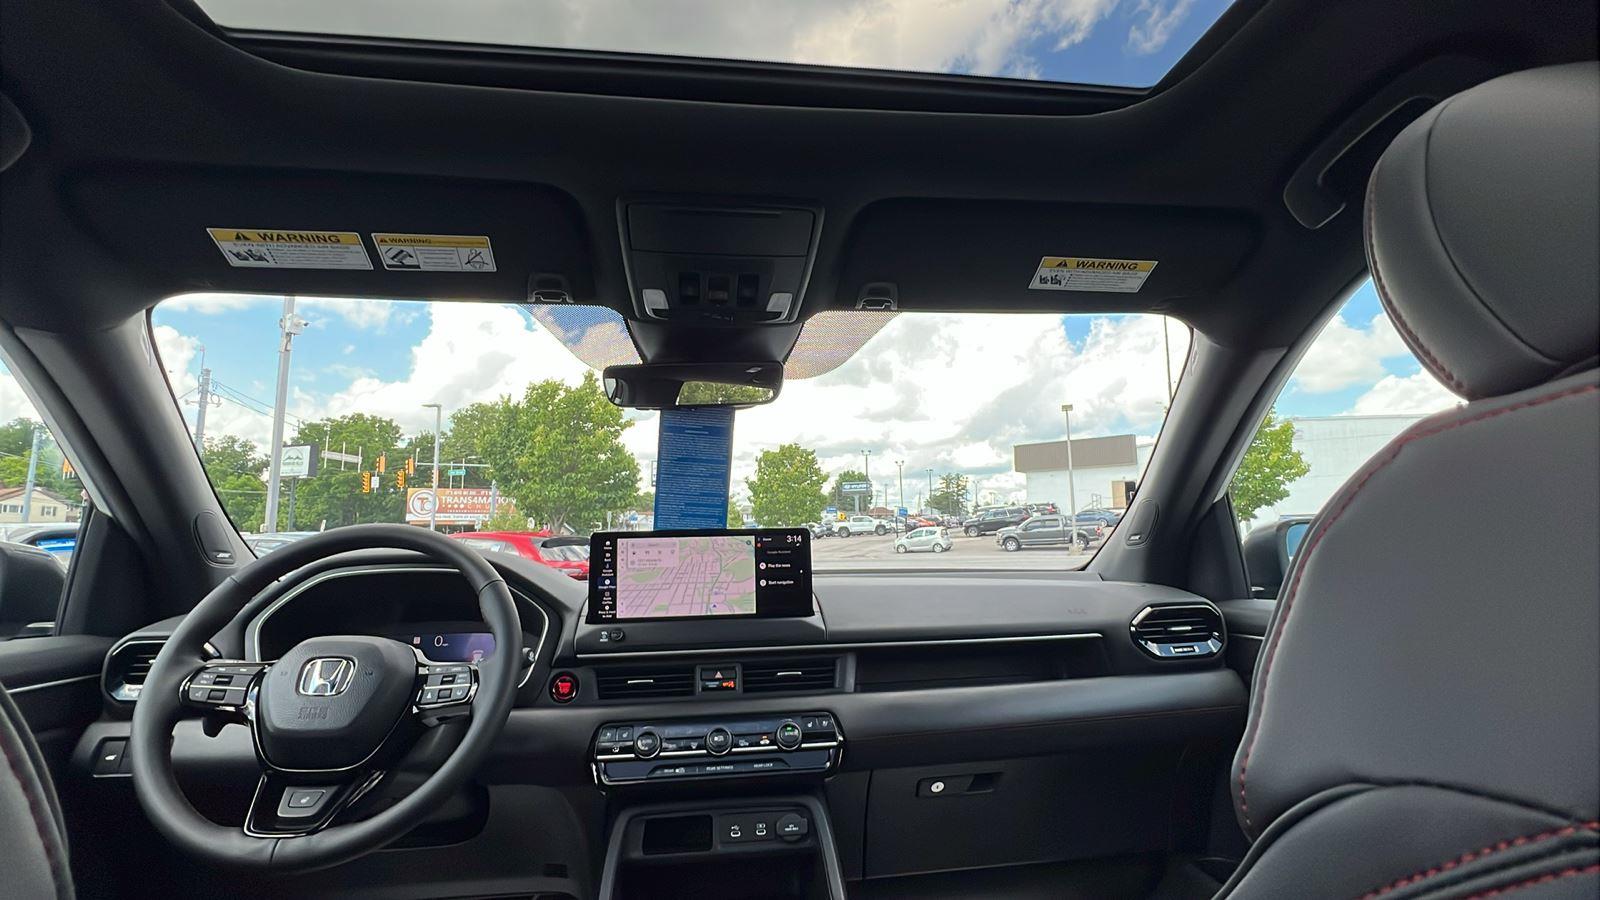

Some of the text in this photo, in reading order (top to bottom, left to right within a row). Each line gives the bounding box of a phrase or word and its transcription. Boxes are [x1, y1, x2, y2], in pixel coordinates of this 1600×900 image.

[257, 232, 341, 243] WARNING
[1076, 260, 1138, 270] WARNING
[434, 635, 443, 647] 0
